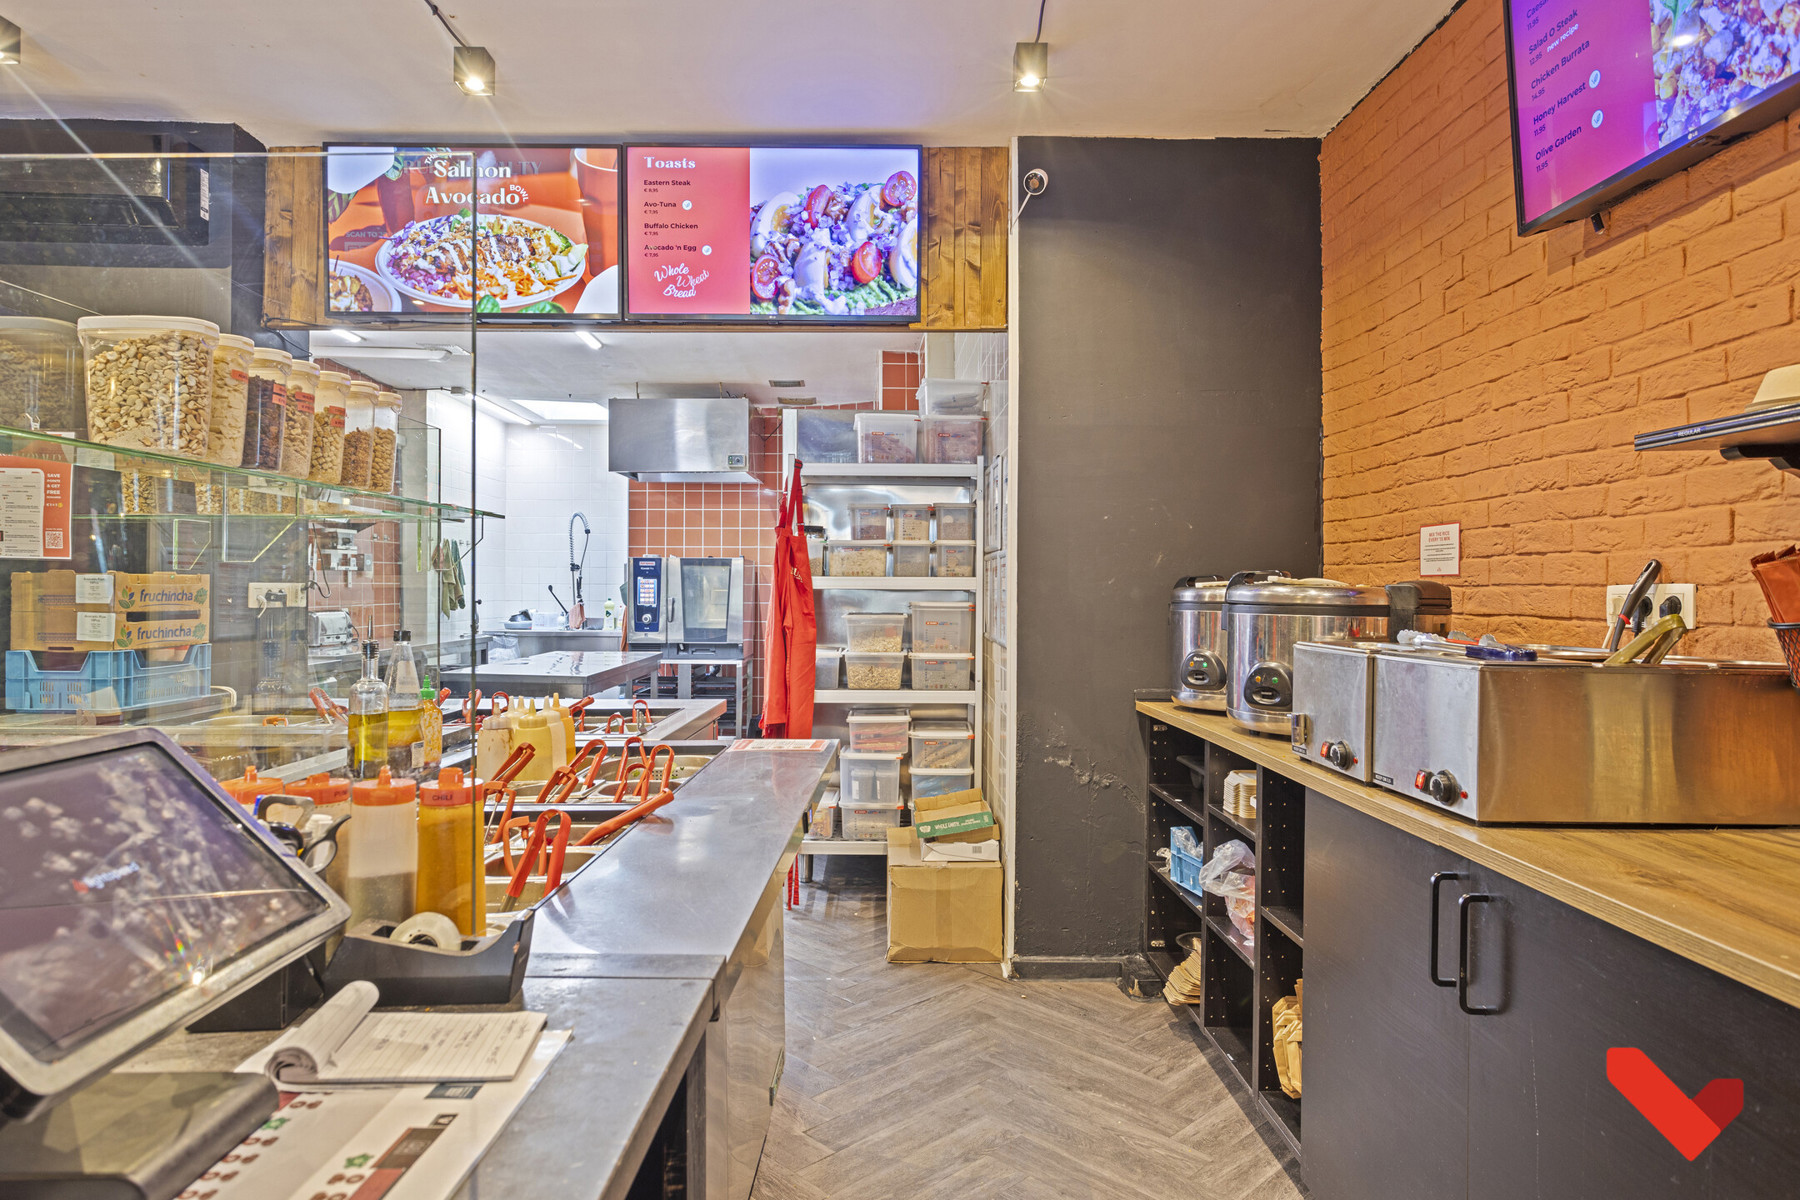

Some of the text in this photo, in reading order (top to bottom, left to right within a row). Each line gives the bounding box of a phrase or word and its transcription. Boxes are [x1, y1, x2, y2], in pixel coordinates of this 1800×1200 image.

[1526, 0, 1548, 18] Caesa
[1528, 9, 1578, 54] Salad O Steak
[1547, 23, 1579, 52] new recipe
[1531, 40, 1590, 89] Chicken Burrata
[1533, 82, 1586, 125] Honey Harvest
[1535, 126, 1582, 161] Olive Garden
[433, 159, 511, 178] Salmon
[643, 156, 696, 169] Toasts
[425, 186, 520, 205] Avocado
[509, 184, 529, 202] BOWL
[653, 262, 690, 282] Whole
[676, 269, 710, 288] Wheat
[663, 284, 697, 298] Bread
[1677, 426, 1701, 437] REGULAR
[139, 588, 193, 602] fruchincha
[137, 625, 192, 640] fruchincha
